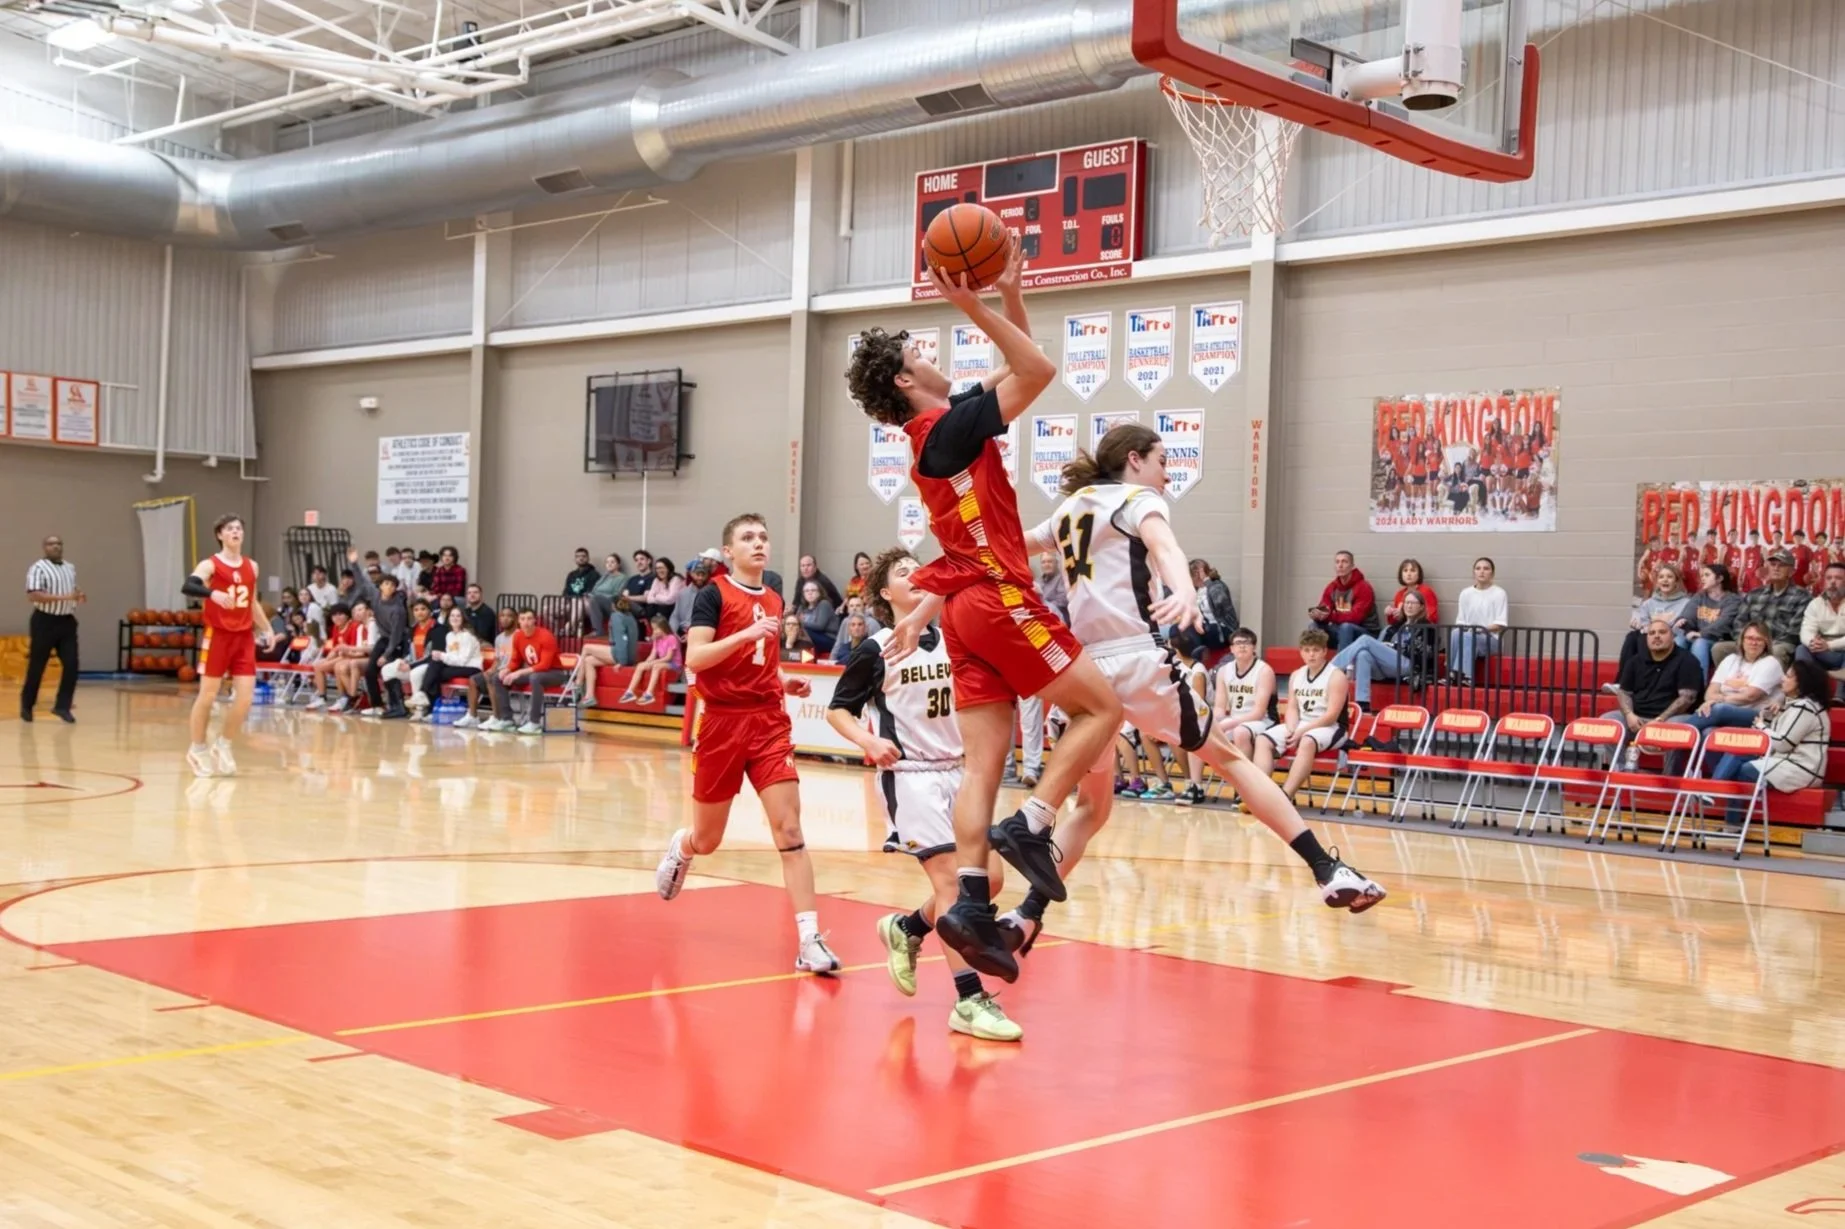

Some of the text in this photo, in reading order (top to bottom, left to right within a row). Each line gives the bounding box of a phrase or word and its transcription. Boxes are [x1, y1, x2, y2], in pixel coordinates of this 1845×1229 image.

[1083, 146, 1128, 169] GUEST
[923, 172, 959, 194] HOME
[1000, 207, 1024, 219] PERIOD
[1101, 213, 1124, 225] FOULS
[1100, 249, 1123, 261] SCORE
[1035, 271, 1089, 287] Construction
[1110, 266, 1128, 276] Inc.
[1067, 349, 1106, 361] VOLLEYBALL
[1129, 345, 1169, 358] BASKETBALL
[1193, 350, 1236, 364] CHAMPION
[954, 358, 989, 370] VOLLEYBALL
[1066, 360, 1106, 373] CHAMPION
[1128, 356, 1169, 370] RUNNERUP
[1137, 371, 1158, 381] 2021
[1203, 365, 1224, 376] 2021
[1075, 374, 1096, 384] 2021
[1210, 377, 1219, 386] 1A
[1082, 385, 1090, 393] 1A
[1144, 382, 1153, 391] 1A
[1376, 392, 1556, 452] RED KINGDOM
[1035, 451, 1072, 461] VOLLEYBALL
[1165, 447, 1199, 458] ENNIS
[1165, 459, 1198, 470] AMPION
[1251, 420, 1262, 509] WARRIORS
[1376, 515, 1479, 526] 2024 LADY WARRIORS
[1642, 489, 1700, 545] RED
[901, 662, 951, 685] BELLEV
[927, 687, 951, 719] 30
[1236, 696, 1244, 709] 3
